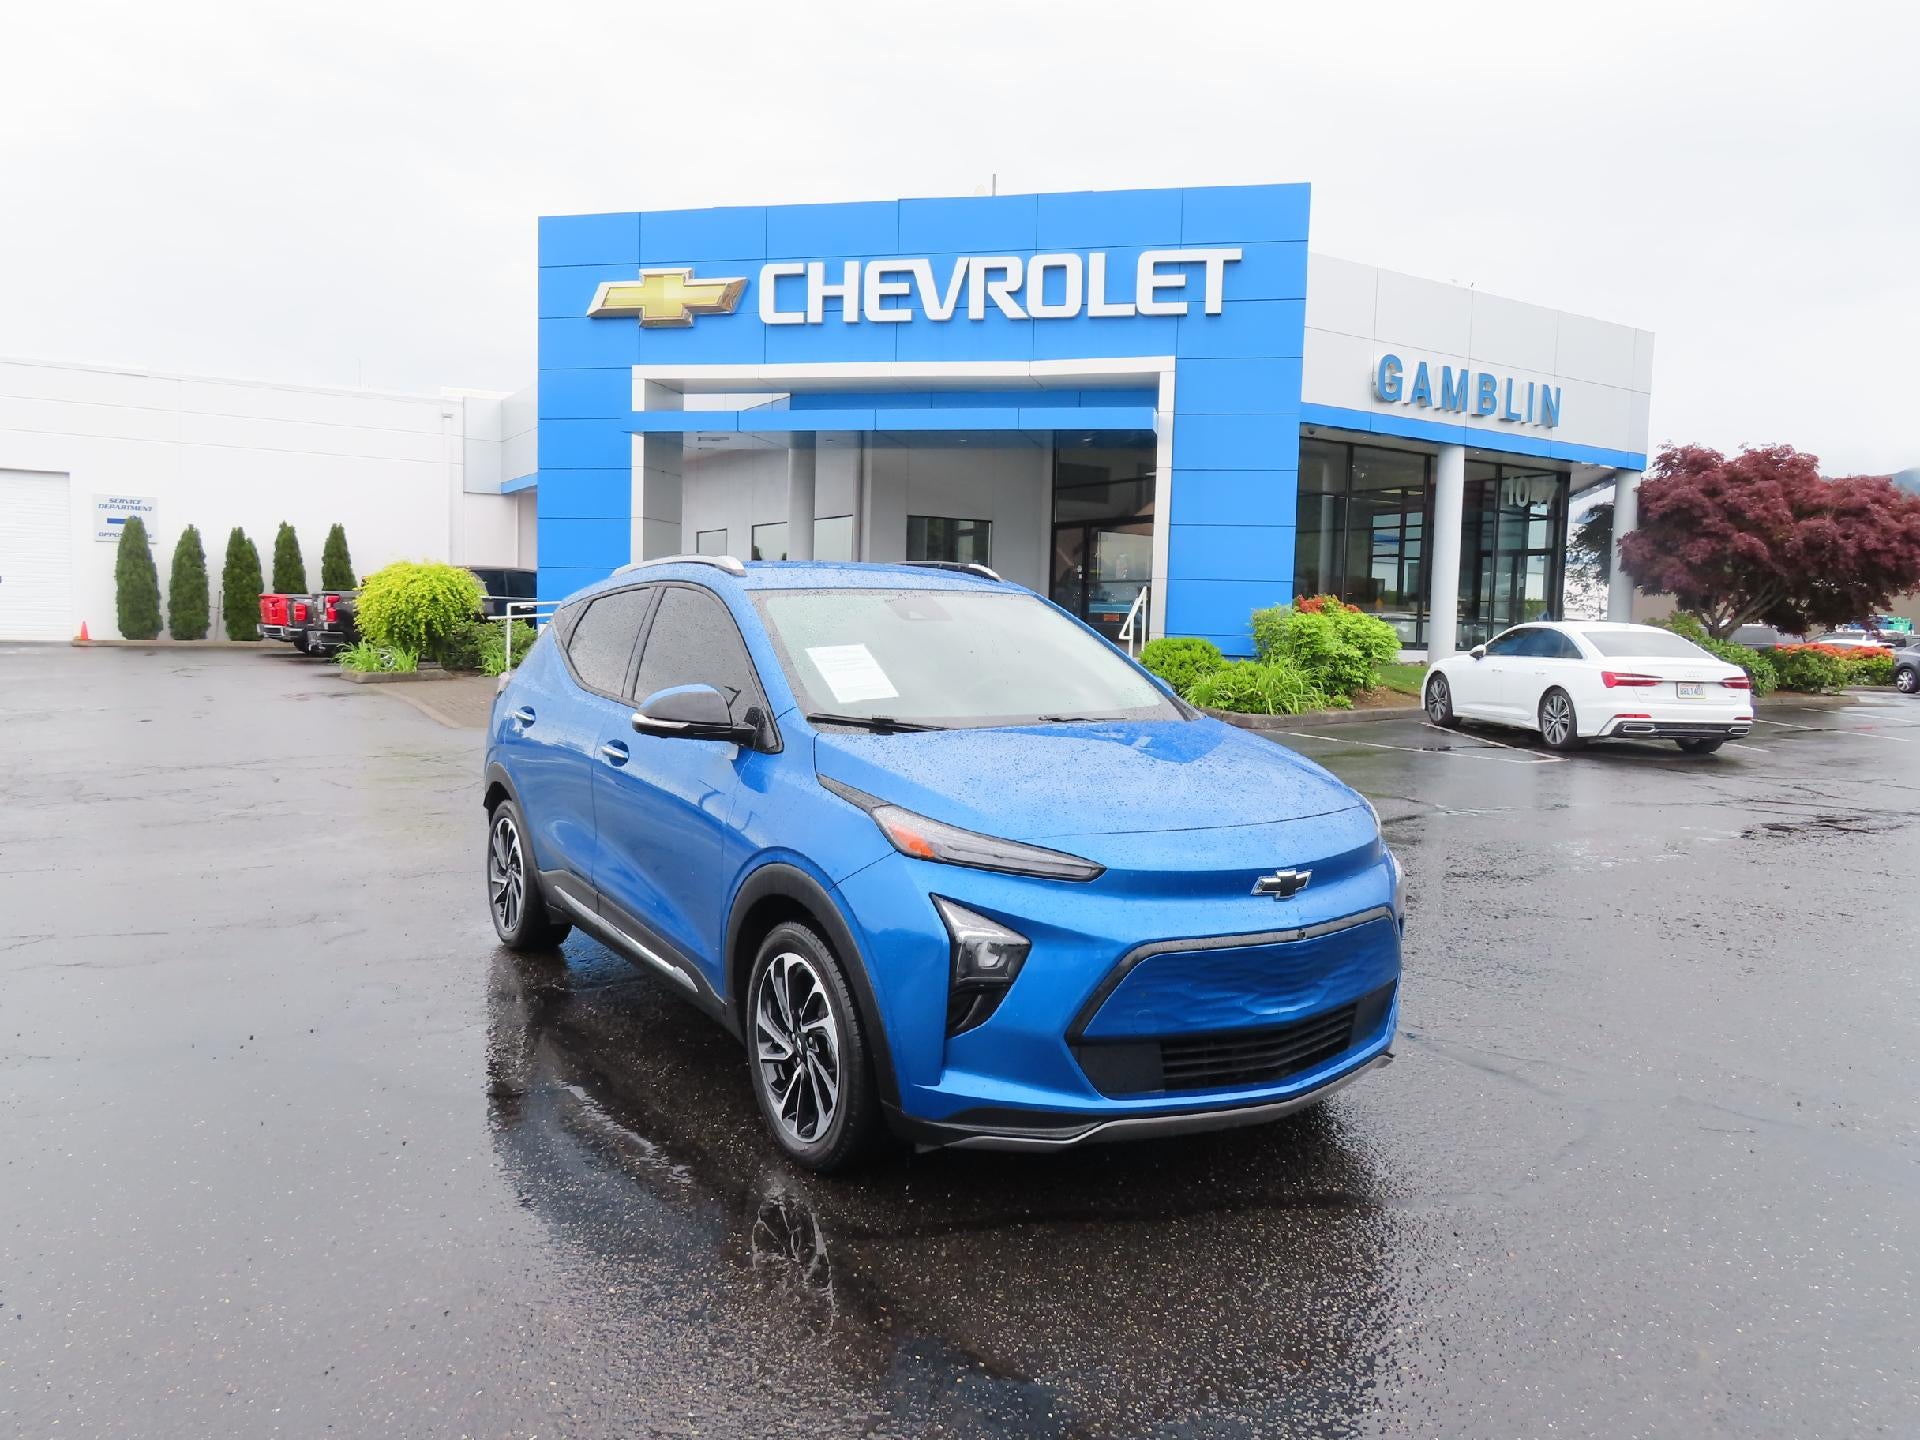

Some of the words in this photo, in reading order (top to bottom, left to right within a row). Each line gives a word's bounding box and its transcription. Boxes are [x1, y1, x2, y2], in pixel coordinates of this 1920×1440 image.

[758, 247, 1243, 325] CHEVROLET
[1375, 353, 1562, 429] GAMBLIN
[98, 503, 153, 511] DEPARTMENT
